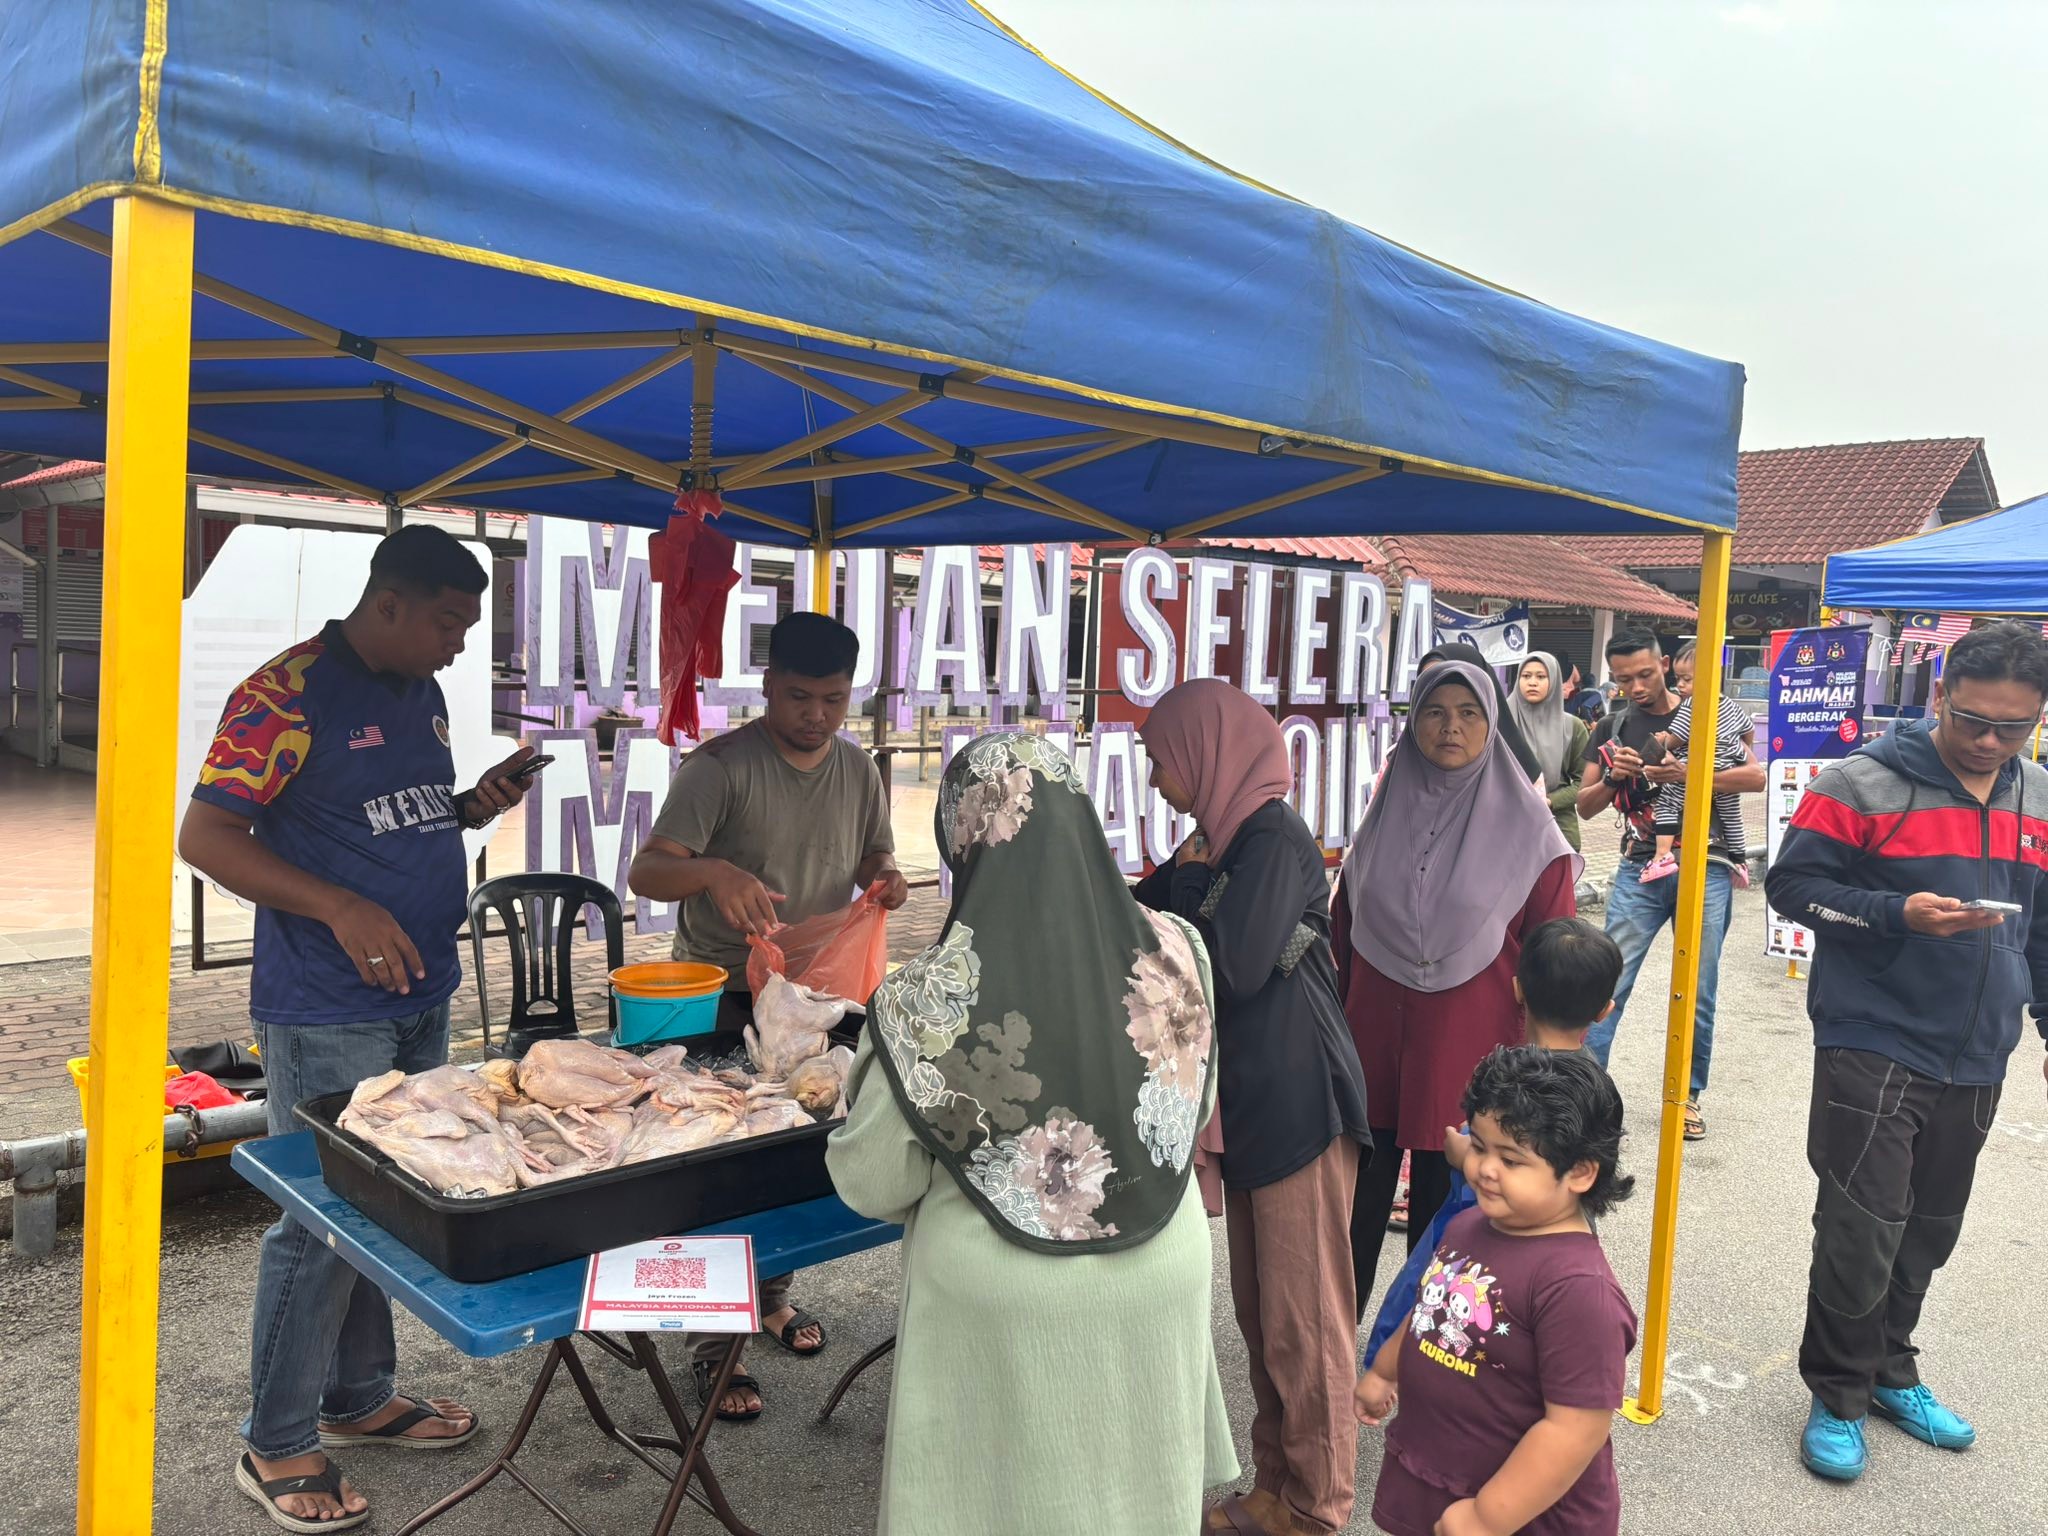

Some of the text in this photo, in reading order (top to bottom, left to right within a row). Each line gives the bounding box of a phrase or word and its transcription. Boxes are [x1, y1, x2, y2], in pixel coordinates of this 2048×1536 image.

[1748, 592, 1779, 605] CAFE
[1117, 547, 1432, 708] SELERA
[1779, 686, 1856, 704] RAHMAH
[1787, 711, 1847, 723] BERGERAK
[363, 785, 457, 836] MERDE
[1419, 1338, 1477, 1377] KUROMI
